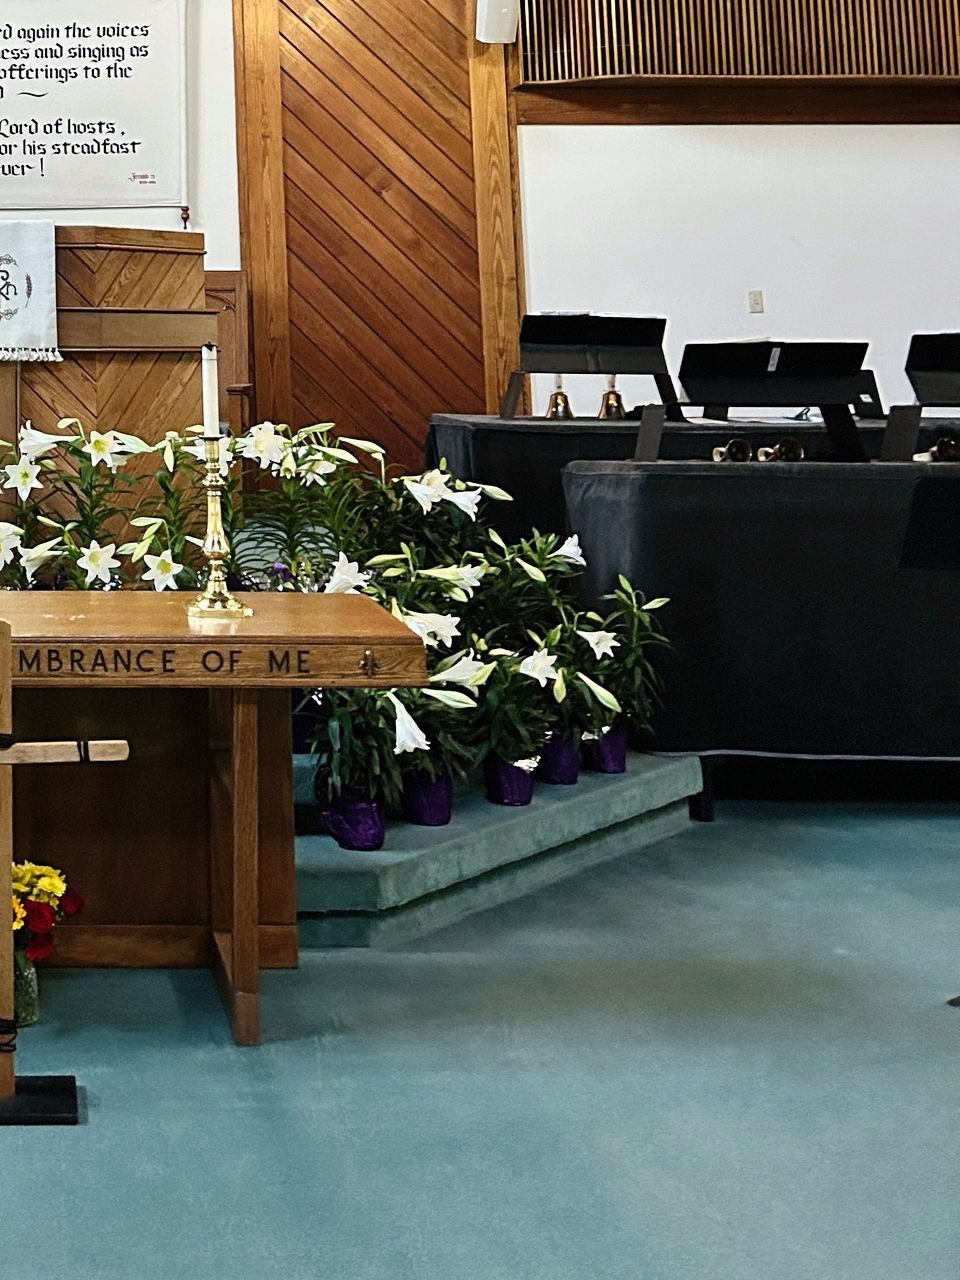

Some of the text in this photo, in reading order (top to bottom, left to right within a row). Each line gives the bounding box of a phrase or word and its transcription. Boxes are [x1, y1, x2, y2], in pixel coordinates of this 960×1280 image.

[17, 24, 60, 43] again
[64, 22, 92, 39] the
[96, 23, 151, 38] voices
[34, 43, 64, 59] and
[67, 43, 126, 63] singing
[129, 45, 149, 58] as
[83, 65, 101, 79] to
[106, 62, 133, 79] the
[43, 118, 63, 135] of
[22, 138, 47, 156] his
[51, 137, 142, 155] steadfast
[202, 650, 244, 673] OF
[268, 650, 312, 673] ME
